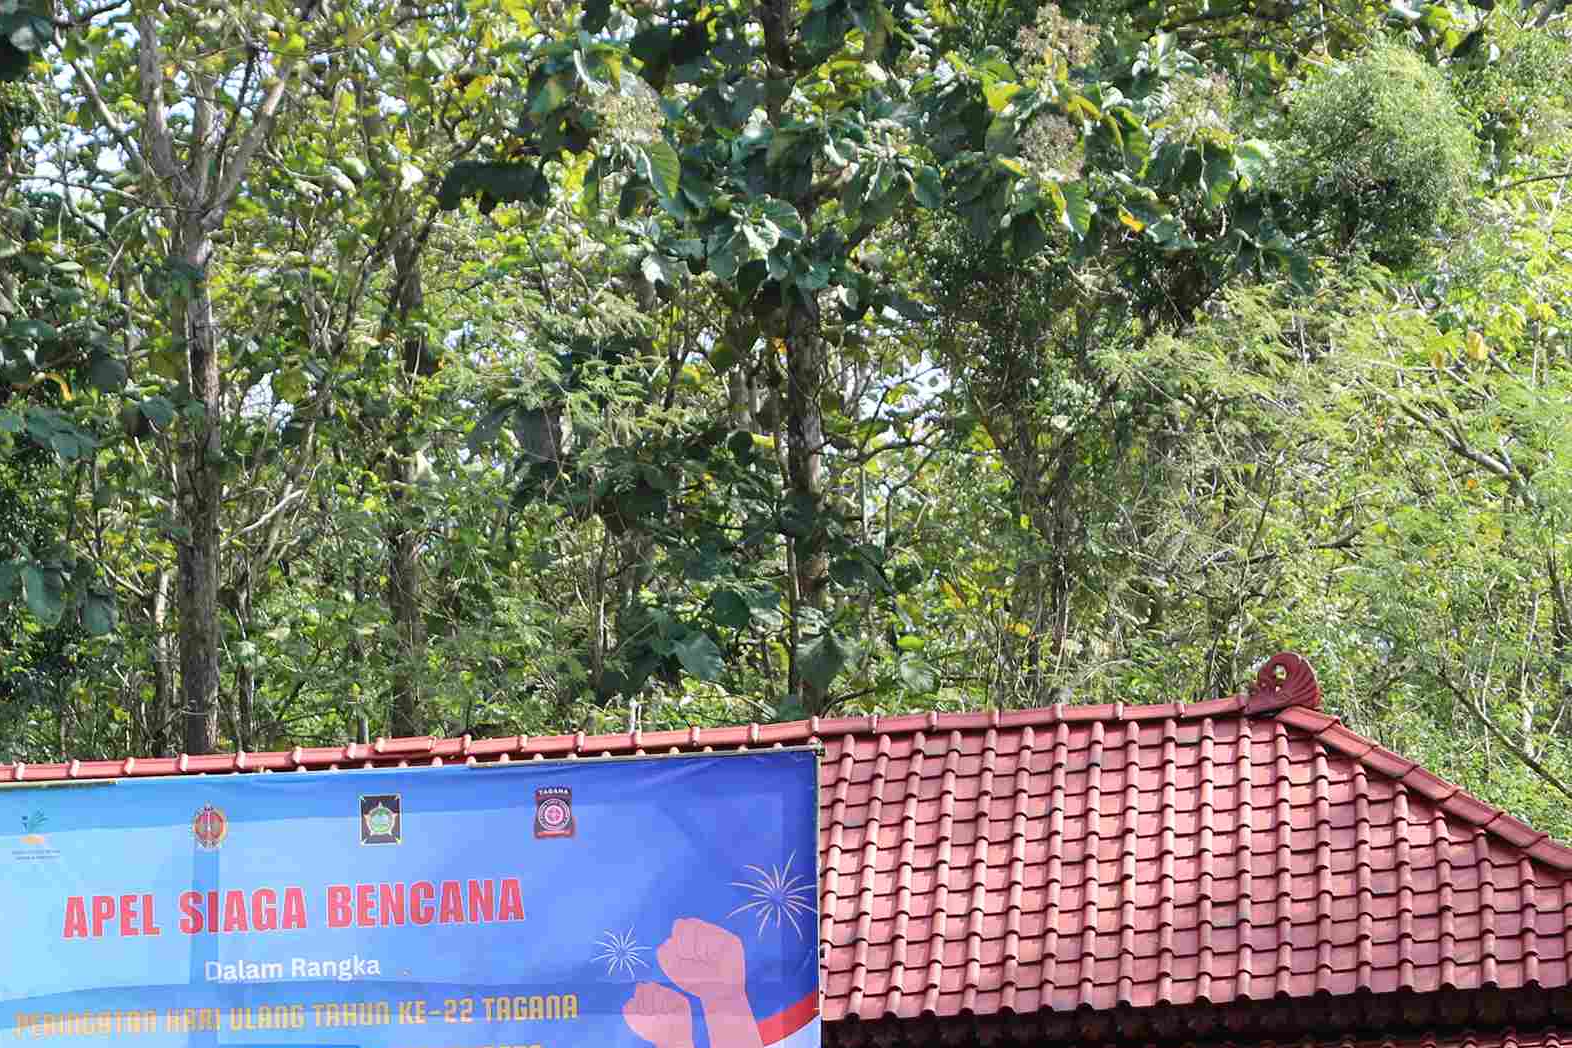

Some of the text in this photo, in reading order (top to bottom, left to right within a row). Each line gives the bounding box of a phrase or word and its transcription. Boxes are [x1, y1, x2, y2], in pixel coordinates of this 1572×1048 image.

[62, 878, 526, 939] APEL SIAGA BENCANA
[205, 956, 381, 982] Dalam Rangka
[166, 1007, 222, 1034] HARI
[230, 1003, 305, 1031] ULANG
[312, 1001, 391, 1028] TAHUN
[397, 997, 475, 1024] KE-22
[482, 994, 579, 1021] TAGANA
